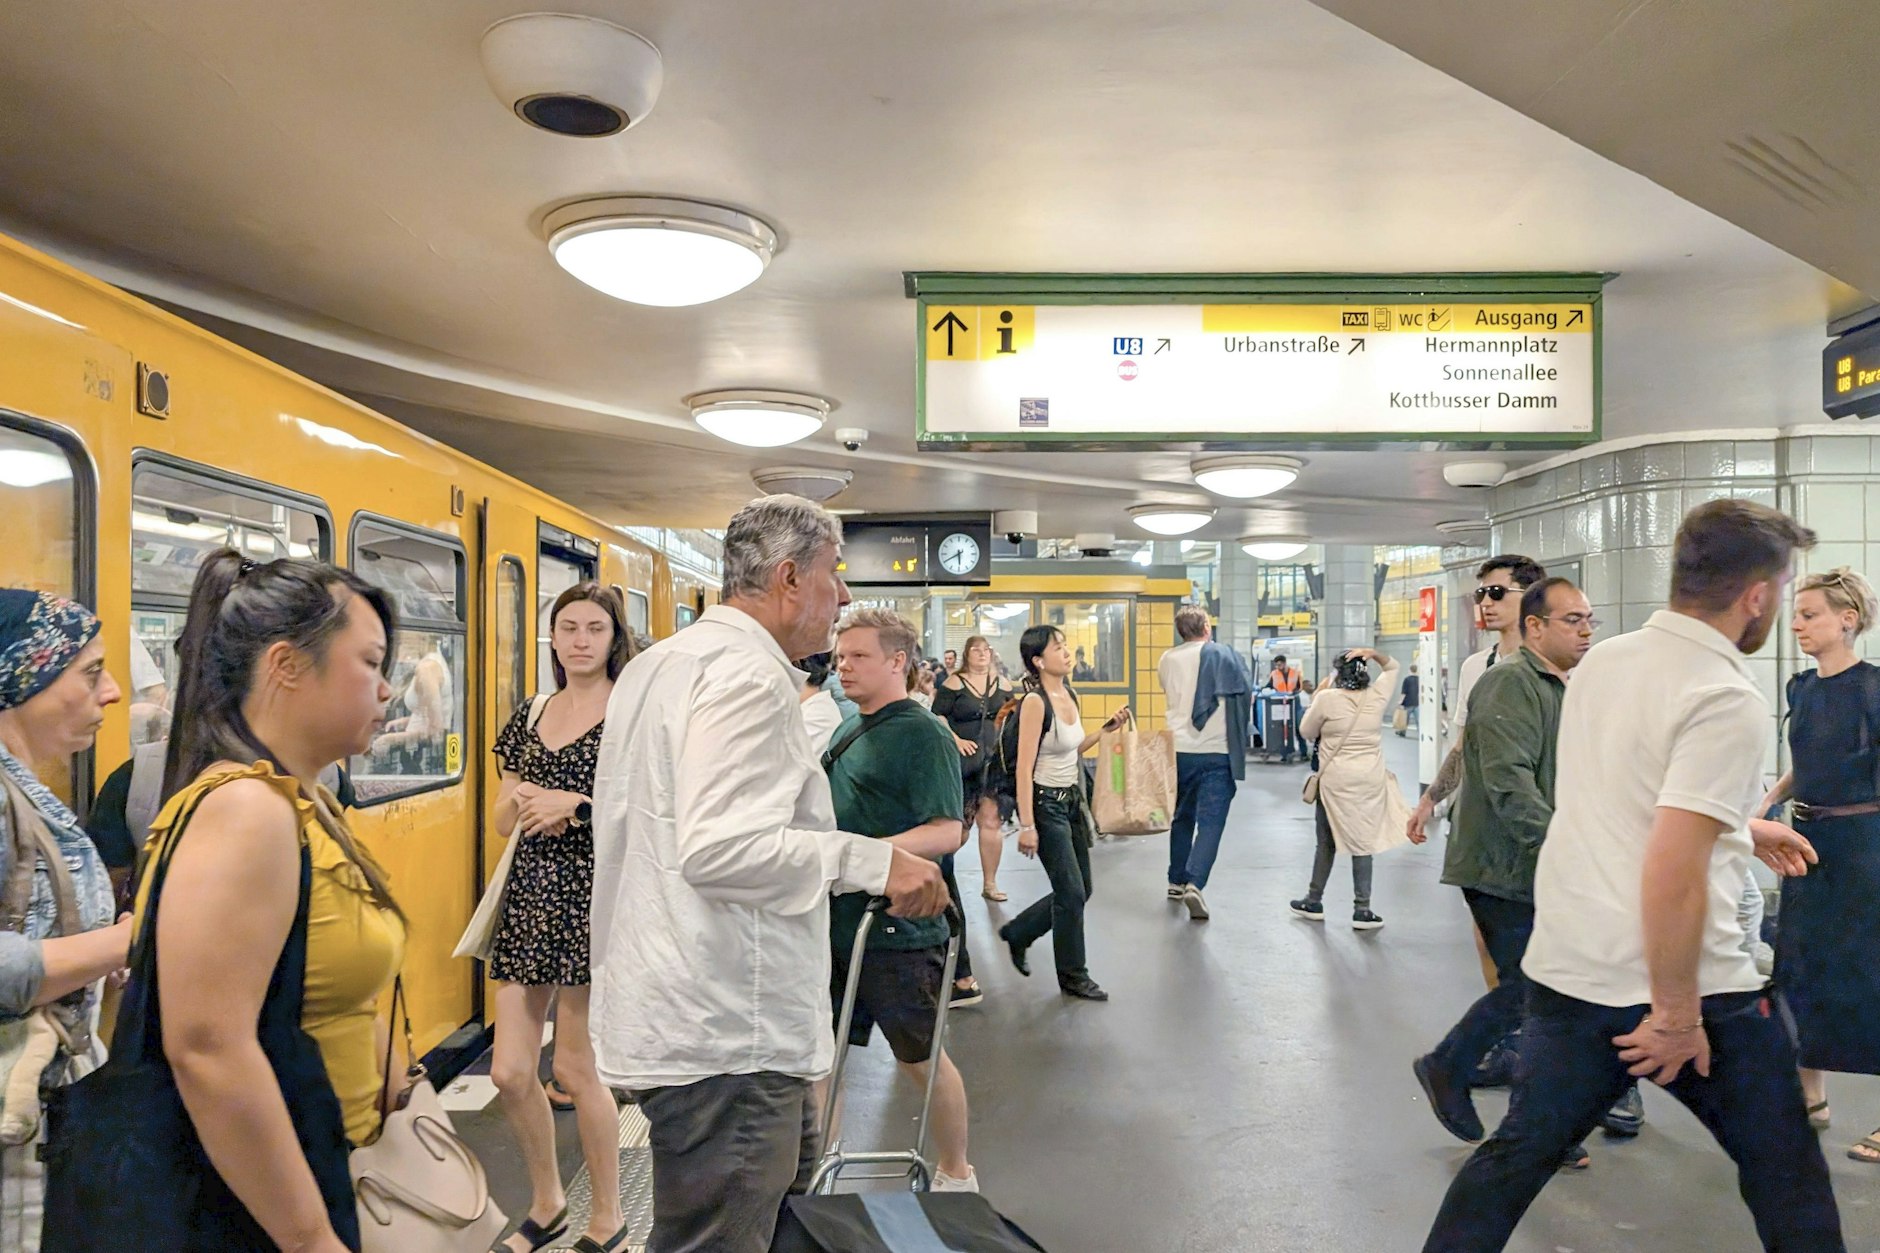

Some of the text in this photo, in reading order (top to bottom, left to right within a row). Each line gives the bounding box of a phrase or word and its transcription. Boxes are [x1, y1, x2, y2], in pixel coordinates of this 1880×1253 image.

[1343, 309, 1557, 330] TAXI WC Ausgang
[1115, 338, 1142, 355] U8
[1224, 335, 1340, 353] Urbanstraße
[1425, 335, 1558, 357] Hermannplatz
[1442, 363, 1558, 381] Sonnenallee
[1838, 358, 1852, 374] U8
[1838, 376, 1852, 392] U8
[1390, 391, 1557, 409] Kottbusser Damm
[890, 536, 916, 545] Abfahrt
